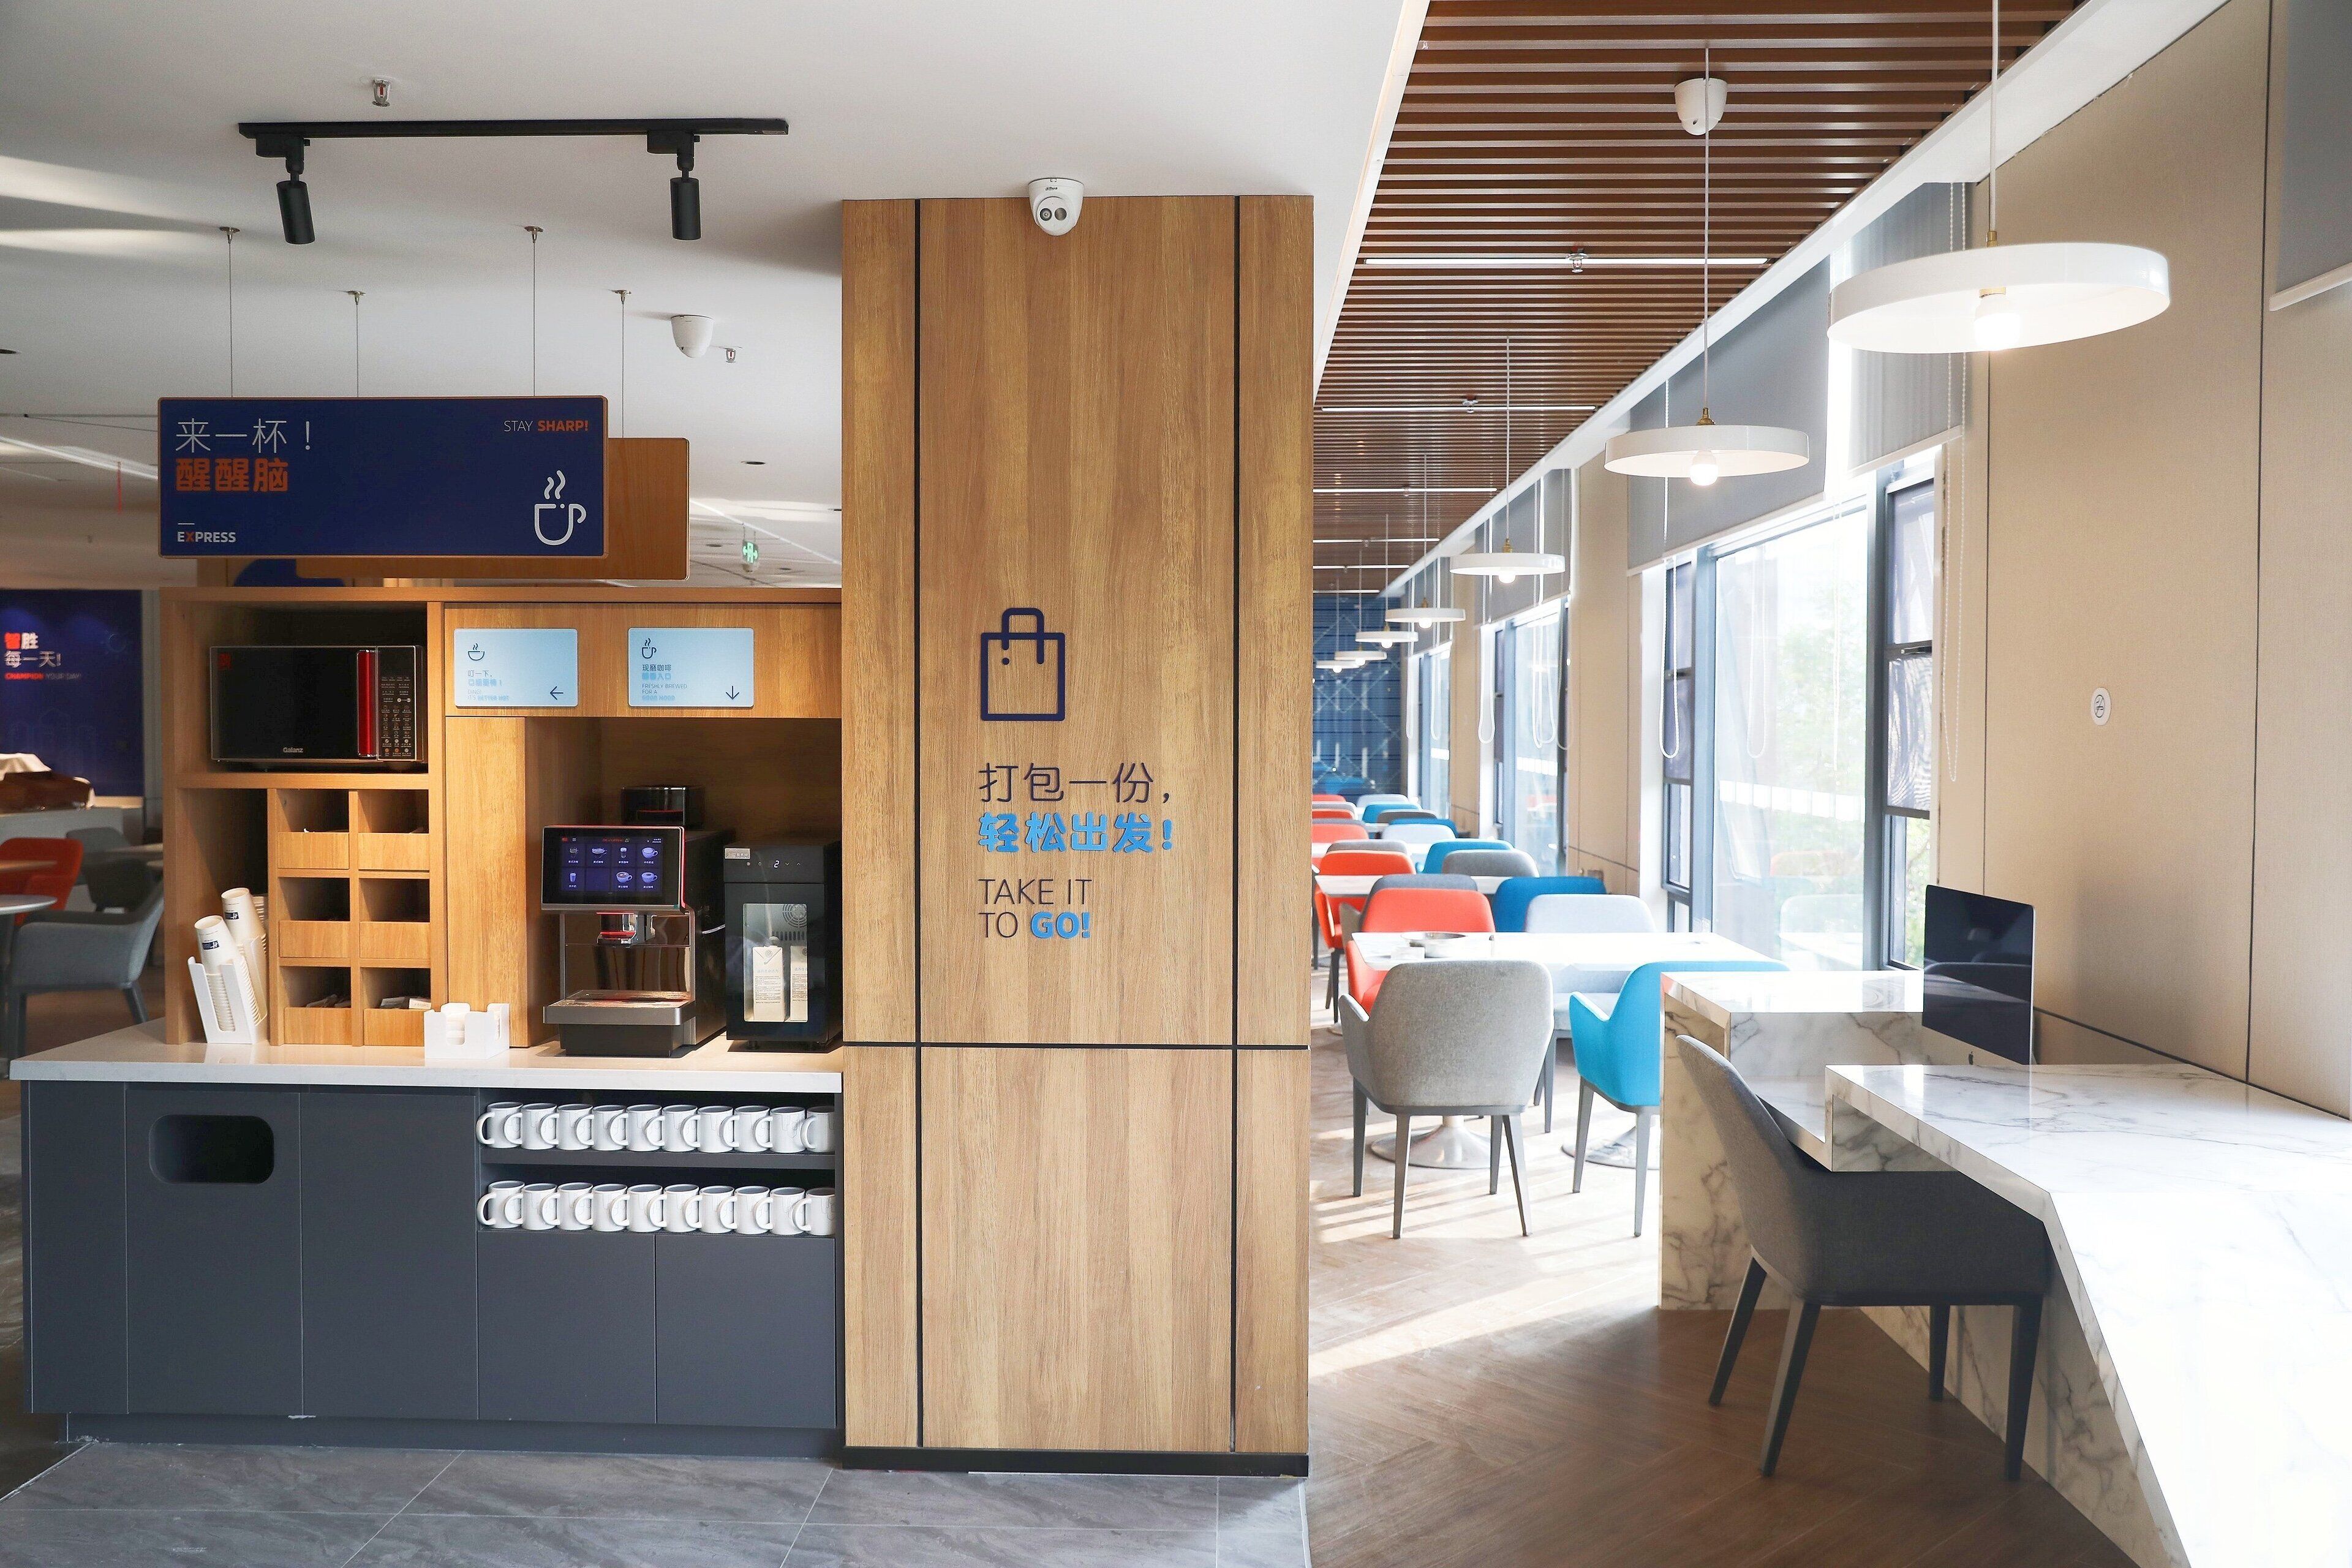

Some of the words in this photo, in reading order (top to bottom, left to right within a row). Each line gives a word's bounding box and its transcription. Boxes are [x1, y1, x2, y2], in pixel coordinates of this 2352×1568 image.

[176, 418, 311, 454] 来一杯！
[504, 420, 534, 432] STAY
[538, 420, 589, 432] SHARP!
[176, 458, 288, 492] 醒醒脑
[178, 532, 236, 543] EXPRESS
[4, 650, 62, 668] 每一天！
[979, 762, 1170, 804] 打包一份，
[978, 812, 1174, 854] 轻松出发！
[978, 878, 1055, 905] TAKE
[1067, 878, 1093, 905] IT
[978, 911, 1019, 939] TO
[1030, 910, 1091, 940] GO!
